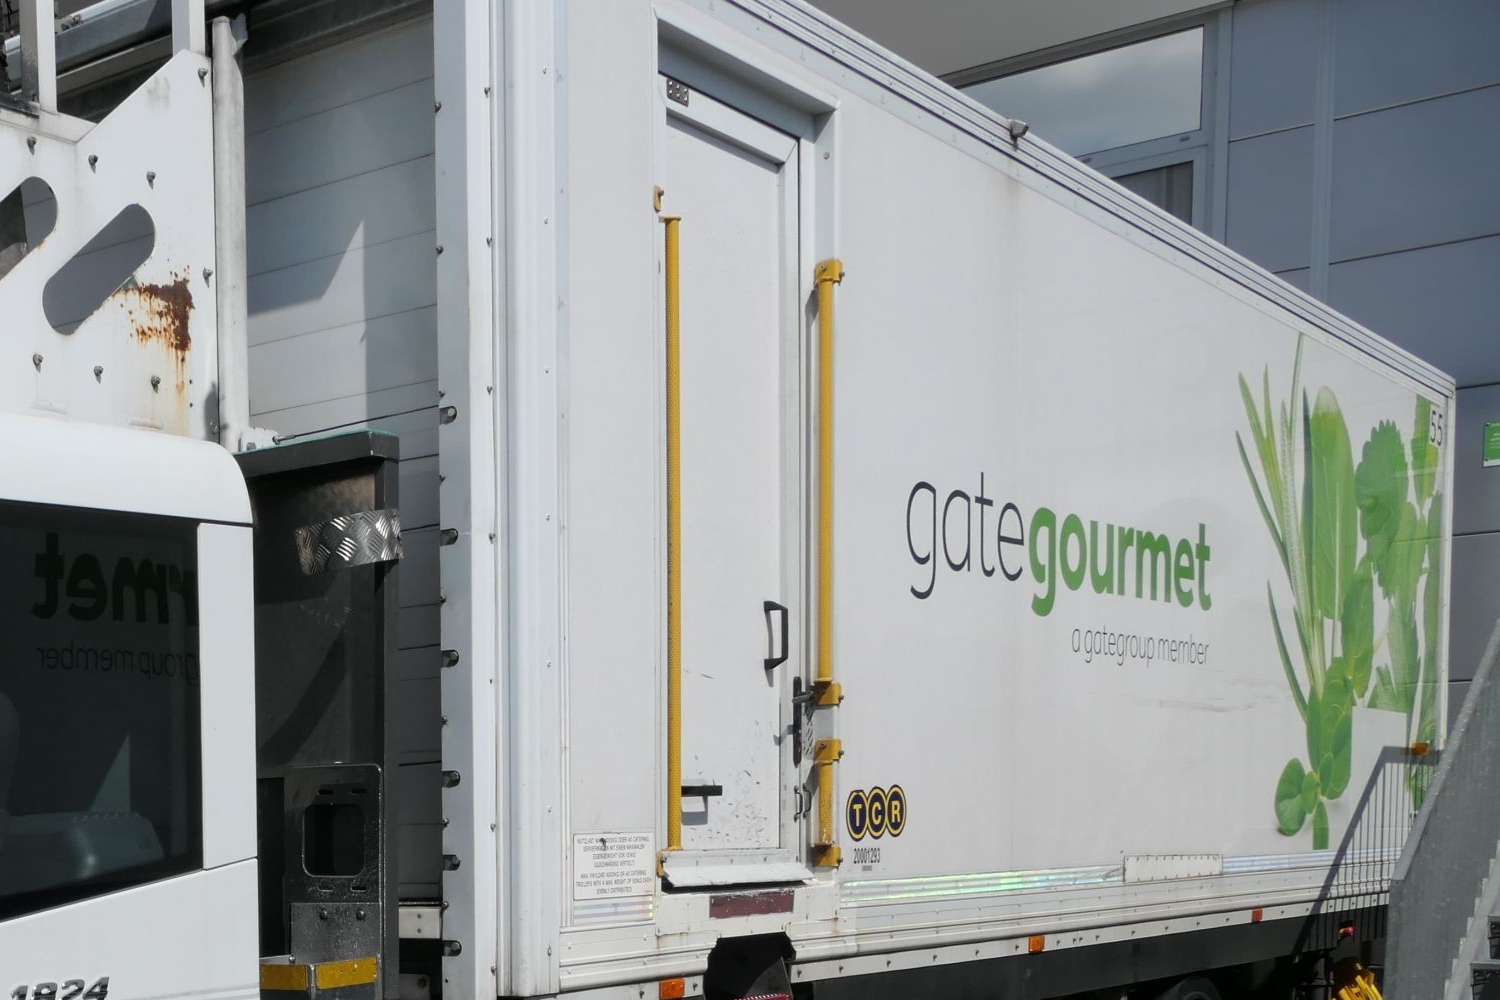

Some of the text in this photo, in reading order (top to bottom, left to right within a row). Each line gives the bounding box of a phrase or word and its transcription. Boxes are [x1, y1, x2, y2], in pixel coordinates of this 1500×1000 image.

[1429, 409, 1443, 446] 55
[907, 471, 1212, 617] gategourmet
[1072, 625, 1209, 668] a gategroup member
[853, 848, 880, 864] 20001293
